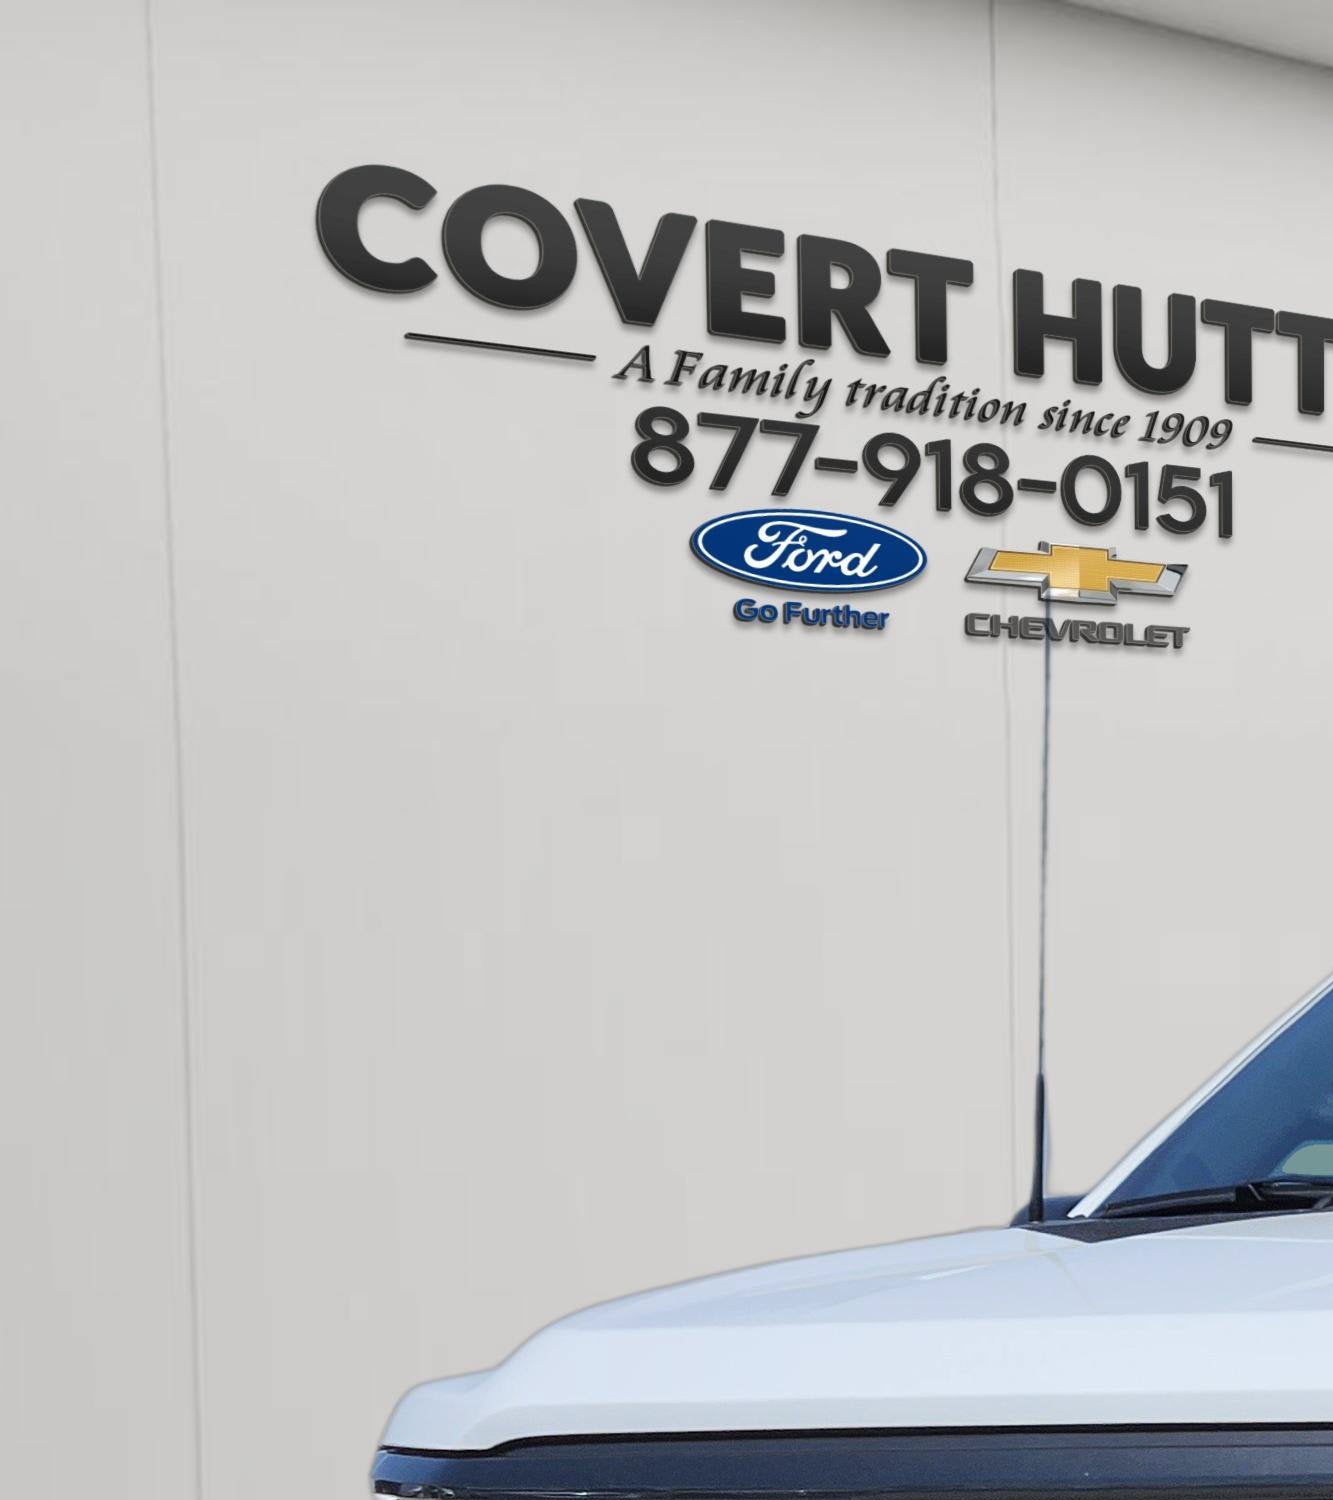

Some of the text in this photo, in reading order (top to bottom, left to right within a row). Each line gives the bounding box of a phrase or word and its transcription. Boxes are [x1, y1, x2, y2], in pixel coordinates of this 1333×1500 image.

[316, 164, 974, 367] COVERT
[612, 345, 1233, 450] A Family tradition since 1909
[630, 406, 1233, 539] 877-918-0151
[743, 520, 882, 577] Ford
[733, 598, 890, 630] Go Further
[964, 613, 1190, 650] CHEVROLET
